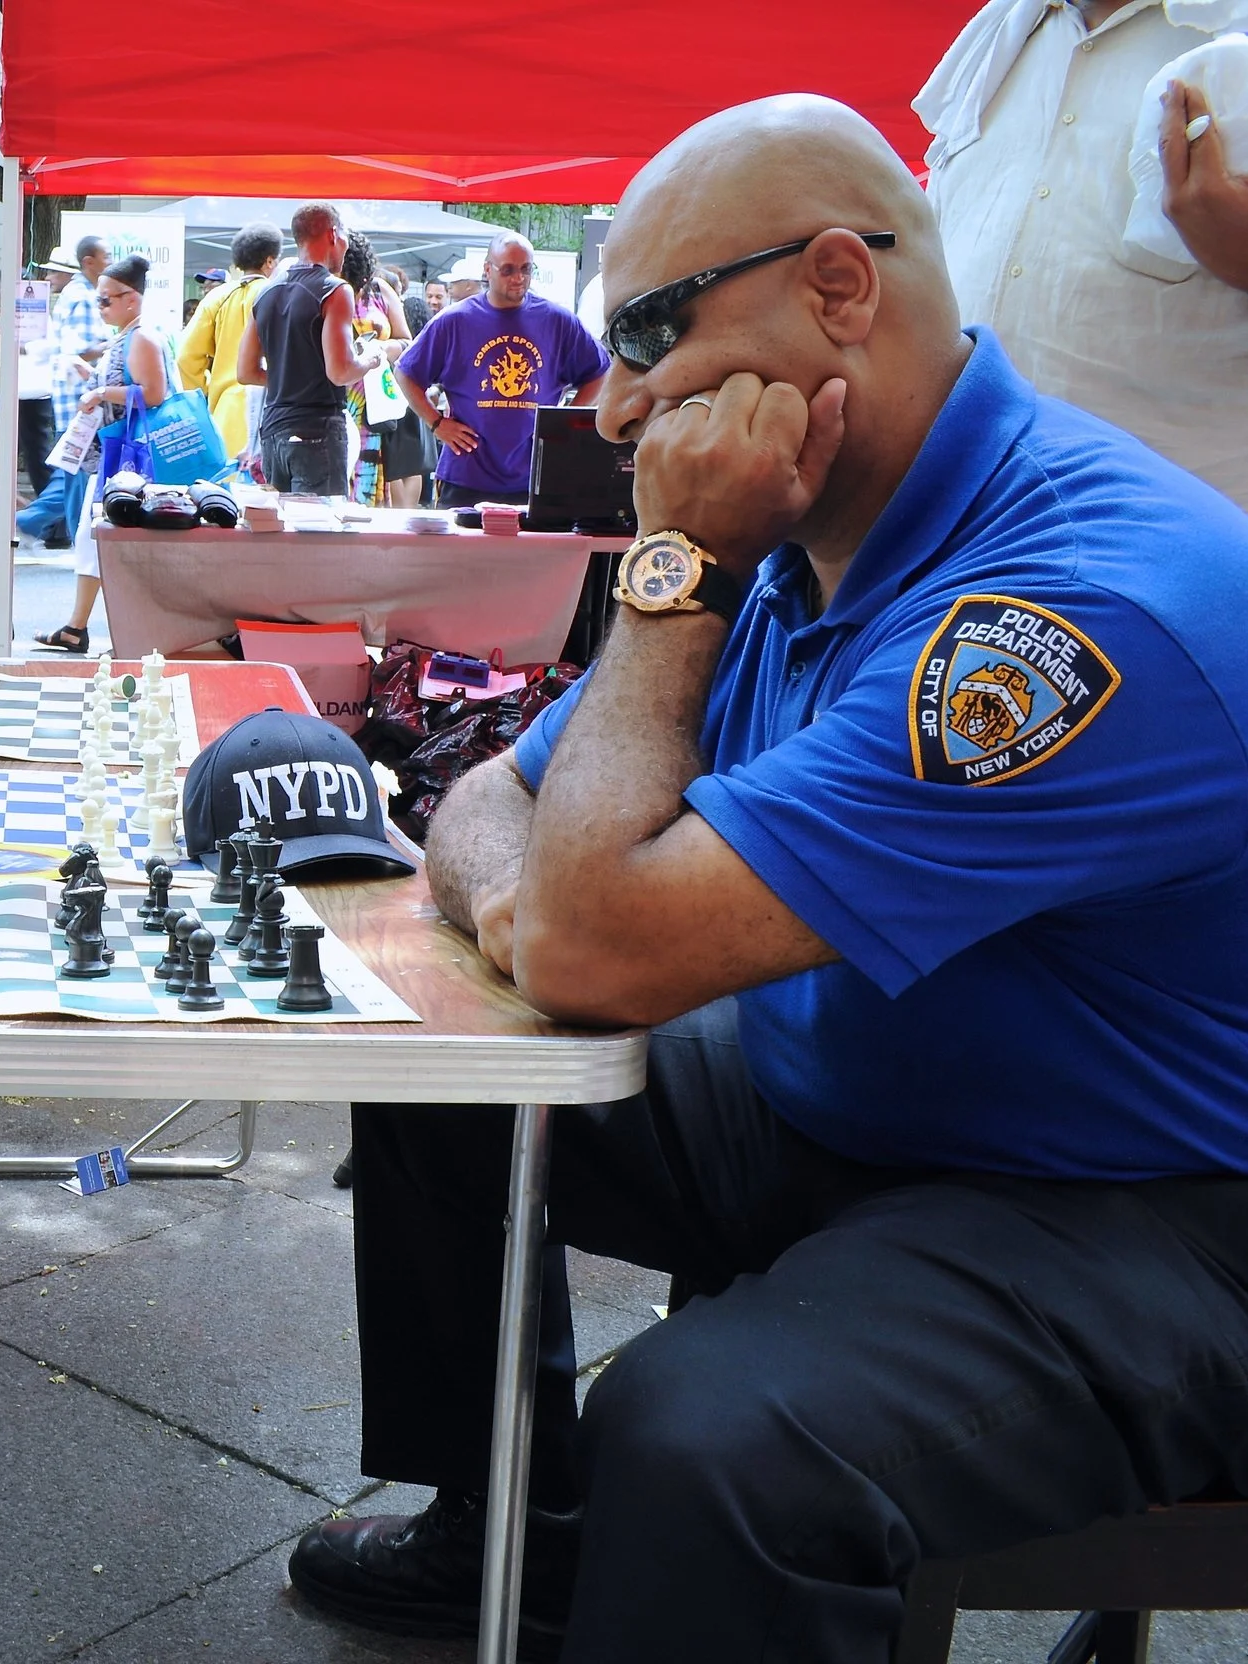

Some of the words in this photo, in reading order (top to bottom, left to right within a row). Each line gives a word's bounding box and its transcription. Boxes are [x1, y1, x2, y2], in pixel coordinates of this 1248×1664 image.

[473, 335, 510, 367] COMBAT
[512, 335, 543, 368] SPORTS
[953, 622, 1090, 705] DEPARTMENT
[998, 608, 1081, 664] POLICE
[922, 658, 946, 705] CITY
[921, 709, 938, 738] OF
[964, 751, 1011, 780] NEW
[1016, 716, 1071, 759] YORK
[232, 761, 368, 831] NYPD
